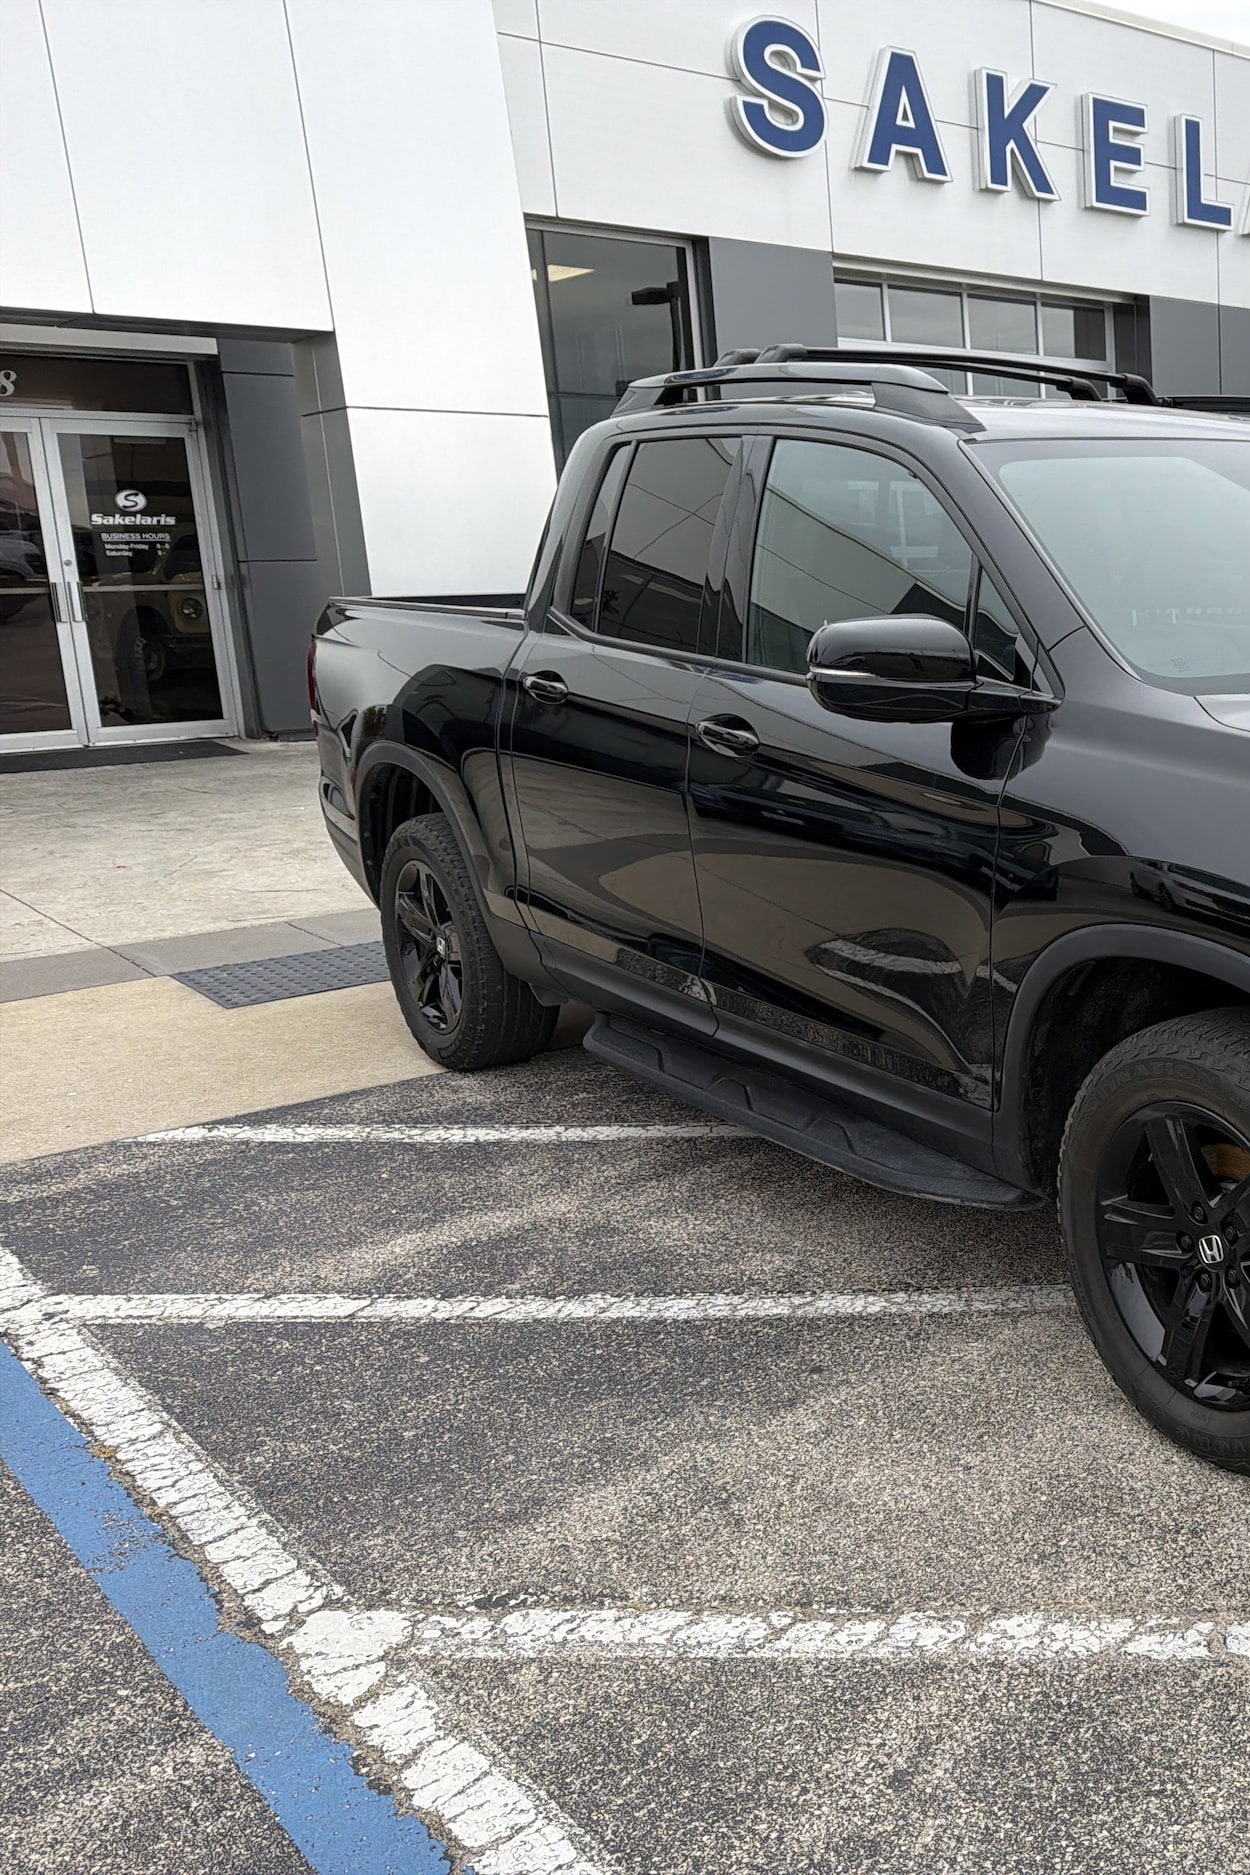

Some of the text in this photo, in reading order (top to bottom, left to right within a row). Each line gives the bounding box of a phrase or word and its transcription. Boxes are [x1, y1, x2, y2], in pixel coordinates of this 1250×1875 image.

[91, 513, 176, 526] Sakelaris
[101, 532, 171, 541] BUSINESS HOURS
